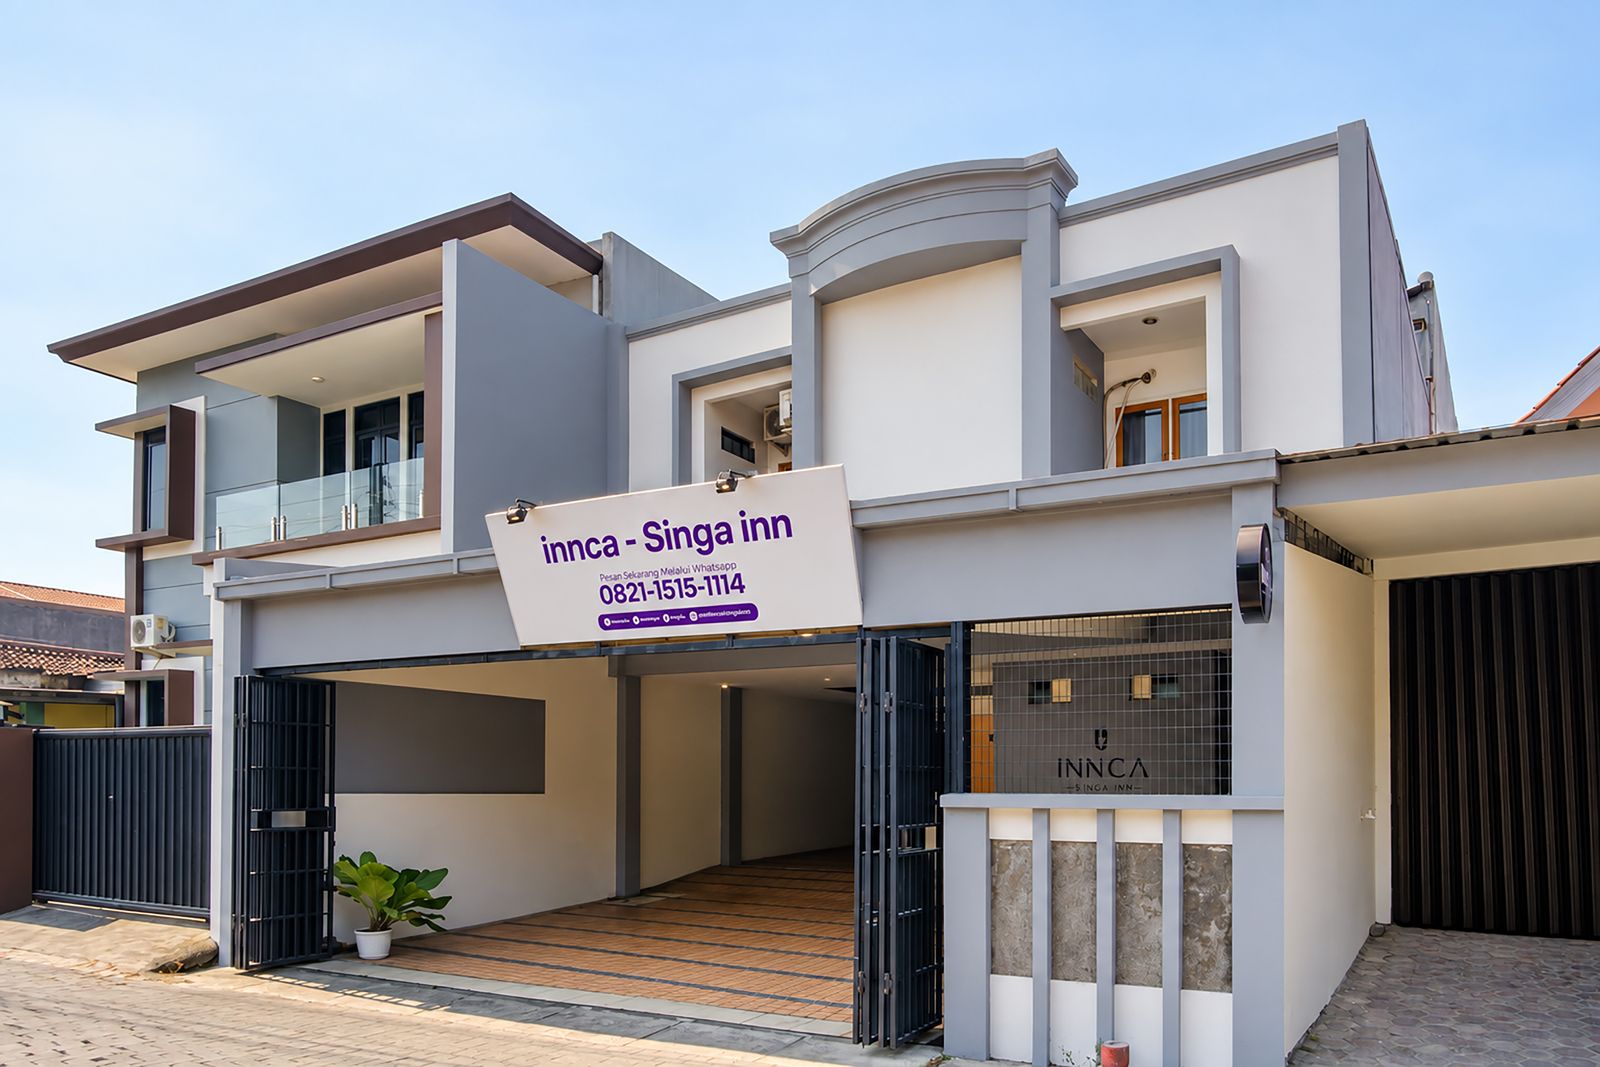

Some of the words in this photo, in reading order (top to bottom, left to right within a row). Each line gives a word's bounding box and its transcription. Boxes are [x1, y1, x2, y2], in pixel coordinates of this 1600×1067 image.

[541, 535, 620, 564] innca
[642, 518, 734, 556] Singa
[738, 510, 793, 543] inn
[599, 573, 622, 582] Pesan
[623, 569, 659, 580] Sekarang
[660, 565, 690, 576] Melalui
[691, 562, 737, 573] Whatsapp
[599, 573, 746, 605] 0821-1515-1114
[1057, 757, 1149, 778] INNCA
[1113, 783, 1133, 792] INN
